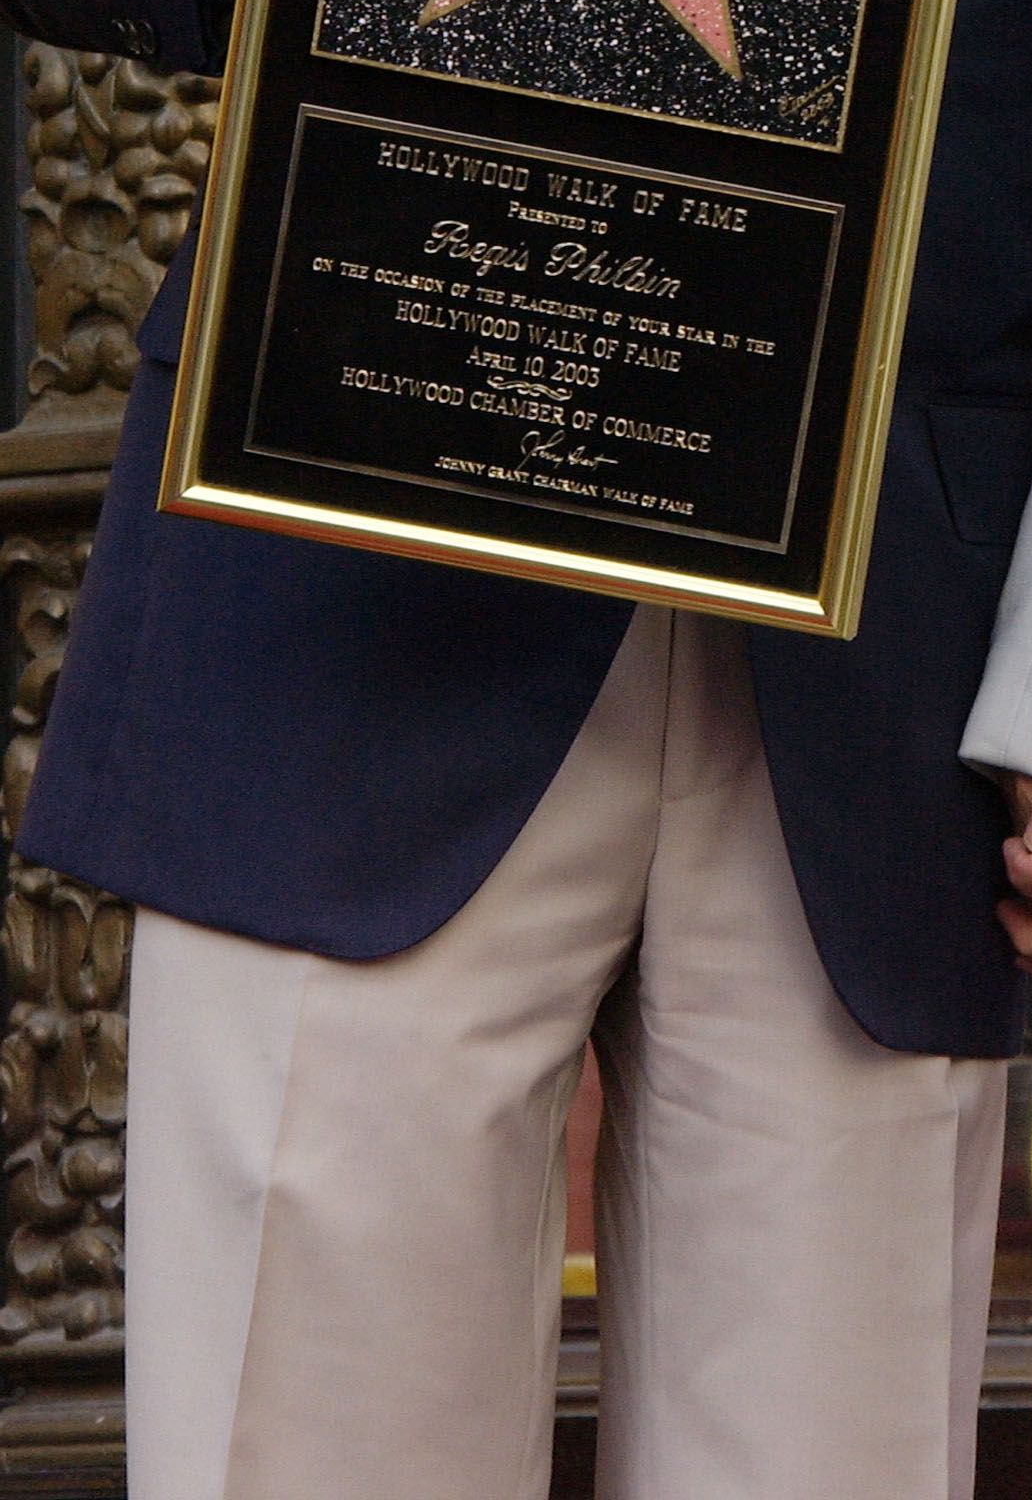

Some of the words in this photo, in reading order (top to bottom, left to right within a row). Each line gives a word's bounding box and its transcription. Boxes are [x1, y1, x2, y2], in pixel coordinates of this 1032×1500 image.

[377, 142, 529, 192] HOLLYWOOD
[548, 173, 618, 208] WALK
[633, 190, 664, 216] OF
[678, 199, 748, 233] FAME
[424, 220, 529, 277] Regis
[544, 242, 681, 299] Philbin
[312, 257, 333, 272] ON
[339, 262, 370, 280] THE
[374, 268, 446, 294] OCCASION
[450, 283, 471, 298] OF
[476, 287, 505, 305] THE
[509, 294, 597, 322] PLACEMENT
[602, 311, 622, 326] OF
[628, 315, 670, 336] YOUR
[676, 325, 716, 345] STAR
[722, 333, 740, 348] IN
[746, 338, 776, 355] THE
[395, 300, 521, 341] HOLLYWOOD
[527, 324, 588, 355] WALK
[593, 337, 620, 360] OF
[624, 342, 682, 372] FAME
[341, 366, 464, 407] HOLLYWOOD
[469, 391, 565, 426] CHAMBER
[572, 410, 598, 431] OF
[603, 416, 712, 453] COMMERCE
[550, 360, 600, 388] 2003
[434, 456, 486, 477] JOHNNY
[488, 465, 530, 484] GRANT
[533, 474, 598, 497] CHAIRMAN
[602, 487, 638, 505] WALK
[641, 495, 657, 507] OF
[658, 498, 695, 515] FAME
